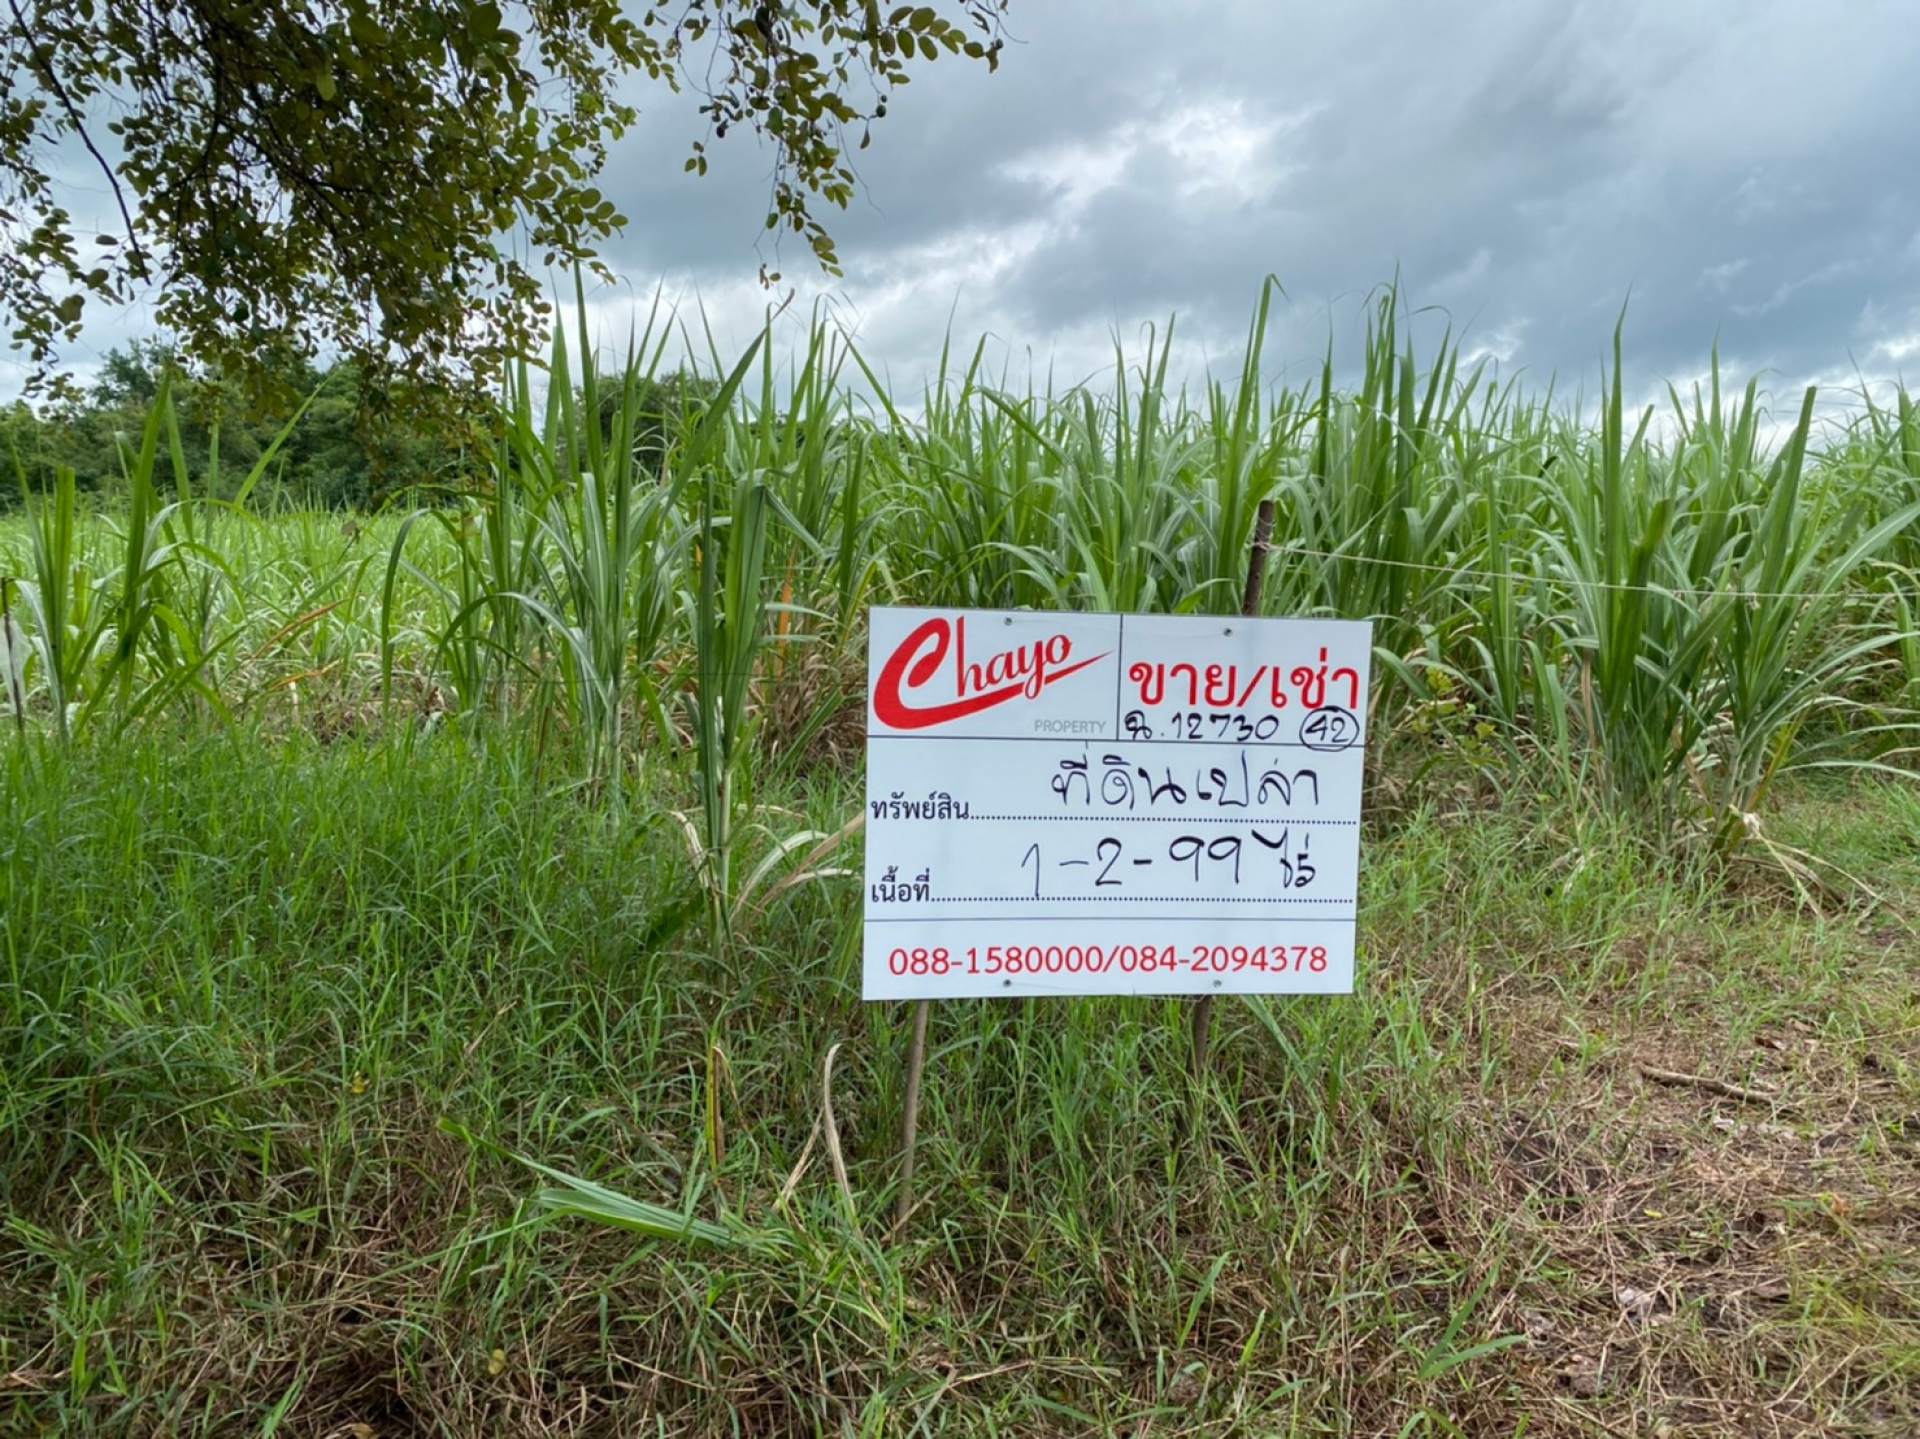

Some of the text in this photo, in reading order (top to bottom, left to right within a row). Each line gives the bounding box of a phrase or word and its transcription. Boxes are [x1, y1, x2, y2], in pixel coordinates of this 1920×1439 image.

[873, 615, 1115, 730] Chayo
[1129, 647, 1360, 710] ขาย/เช่า
[1034, 719, 1107, 734] PROPERTY
[1303, 711, 1351, 745] 42
[1051, 741, 1319, 810] ที่ดินเปล่า
[870, 791, 970, 820] ทรัพย์สิน
[871, 865, 931, 903] เนื้อที่
[889, 945, 1328, 976] 088-1580000/084-2094378
